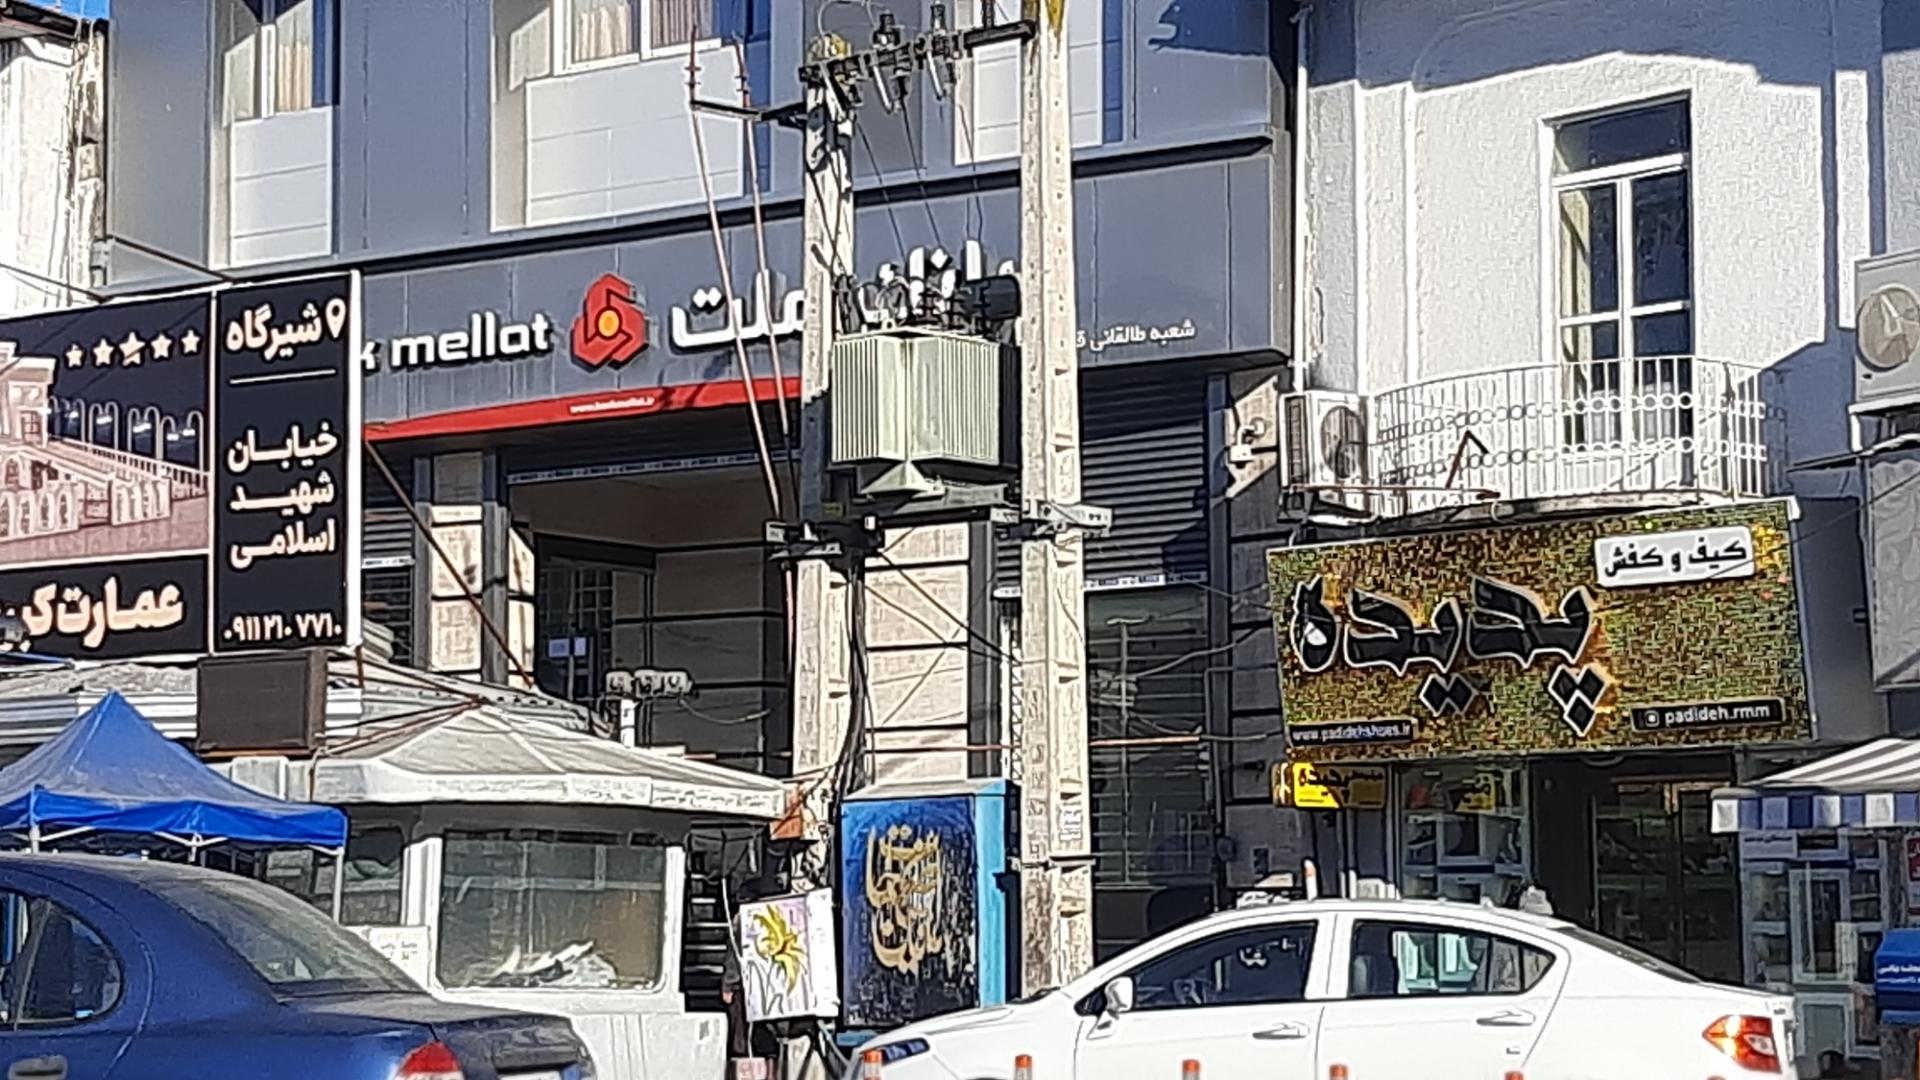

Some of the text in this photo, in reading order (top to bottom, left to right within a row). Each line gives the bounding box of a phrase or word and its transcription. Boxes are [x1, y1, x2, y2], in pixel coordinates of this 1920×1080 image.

[226, 302, 322, 361] شیرگاه
[391, 310, 550, 367] mellat
[1089, 325, 1147, 352] طالقانی
[1149, 318, 1196, 346] شعبه
[228, 421, 338, 473] خیابان
[230, 470, 334, 517] شهید
[230, 517, 336, 569] اسلامی
[1604, 536, 1748, 577] کیف و کفش
[57, 576, 183, 648] عمارت
[1290, 573, 1607, 738] پدیده
